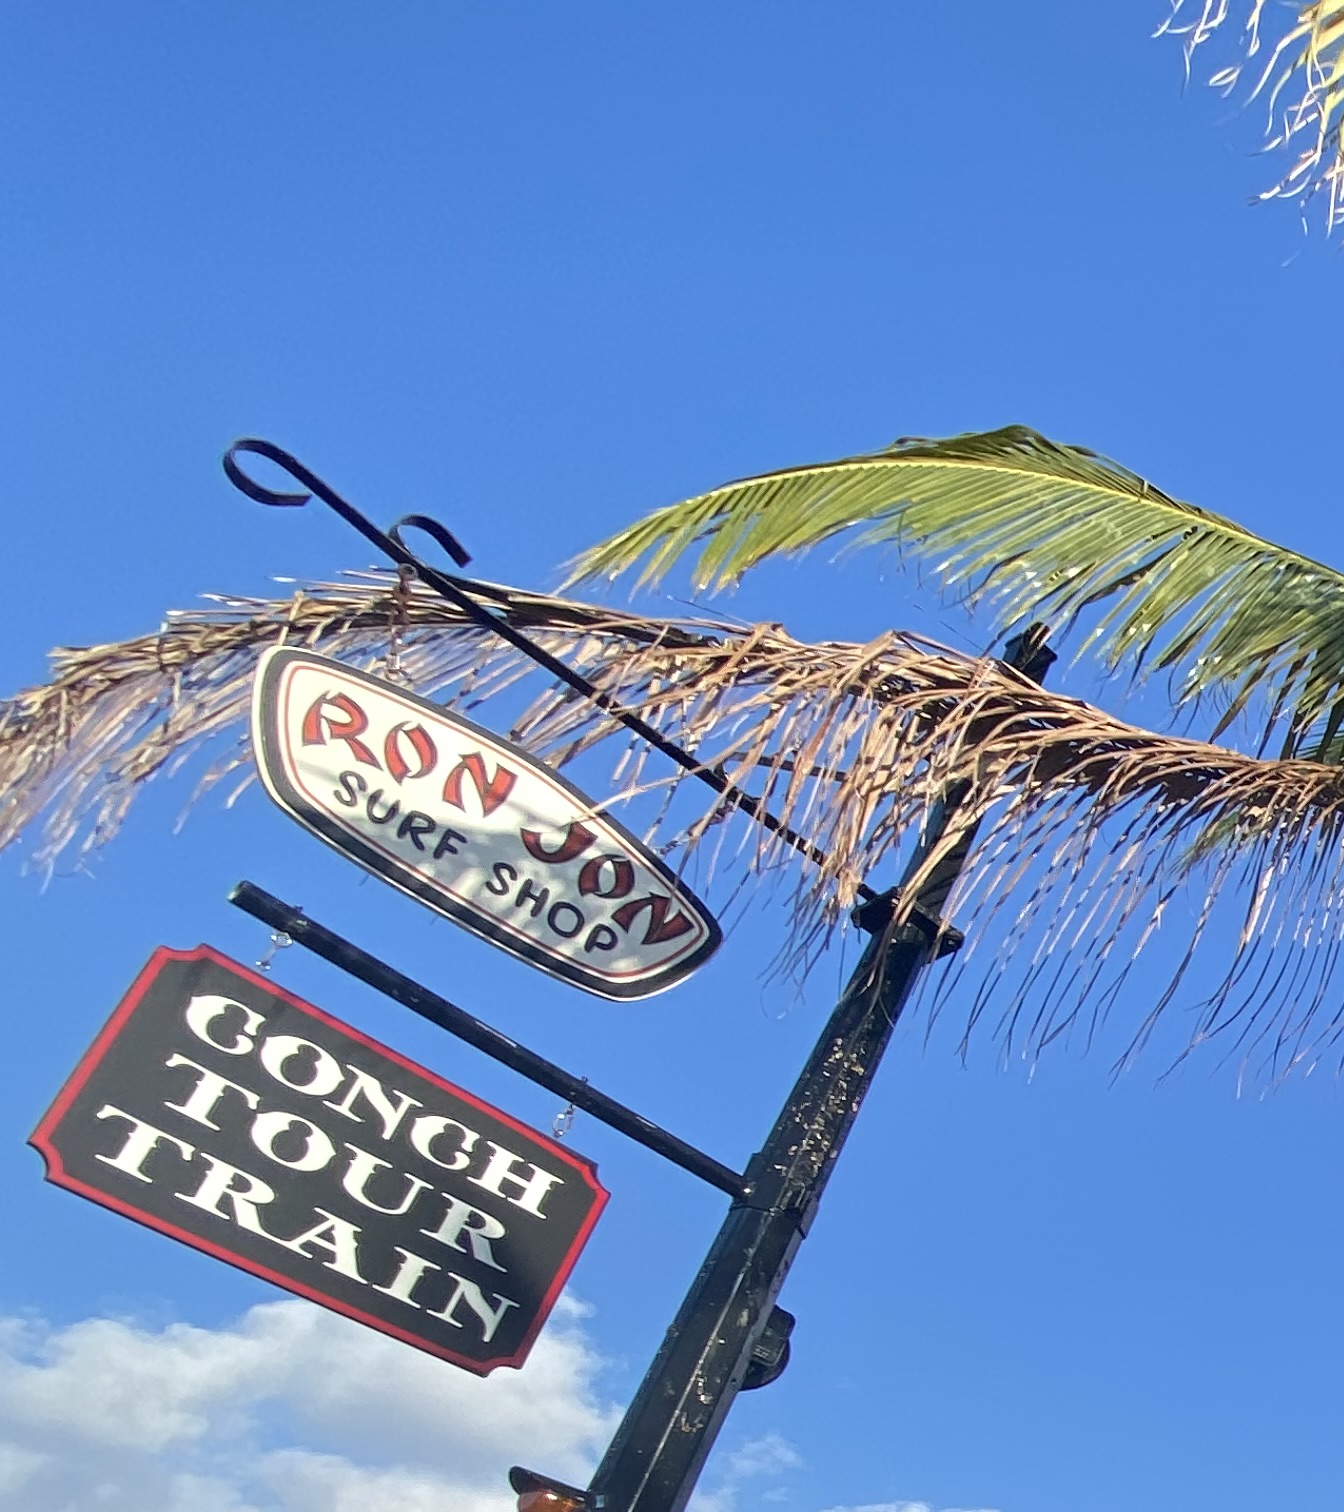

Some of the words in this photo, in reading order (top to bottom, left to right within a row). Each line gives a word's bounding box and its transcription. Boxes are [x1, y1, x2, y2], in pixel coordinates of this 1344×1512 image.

[303, 691, 517, 817] RON
[520, 819, 696, 946] JON
[333, 773, 468, 861] SURF
[485, 861, 620, 955] SHOP
[164, 1053, 507, 1273] TOUR
[185, 994, 565, 1221] CONCH
[95, 1104, 520, 1343] TRAIN
